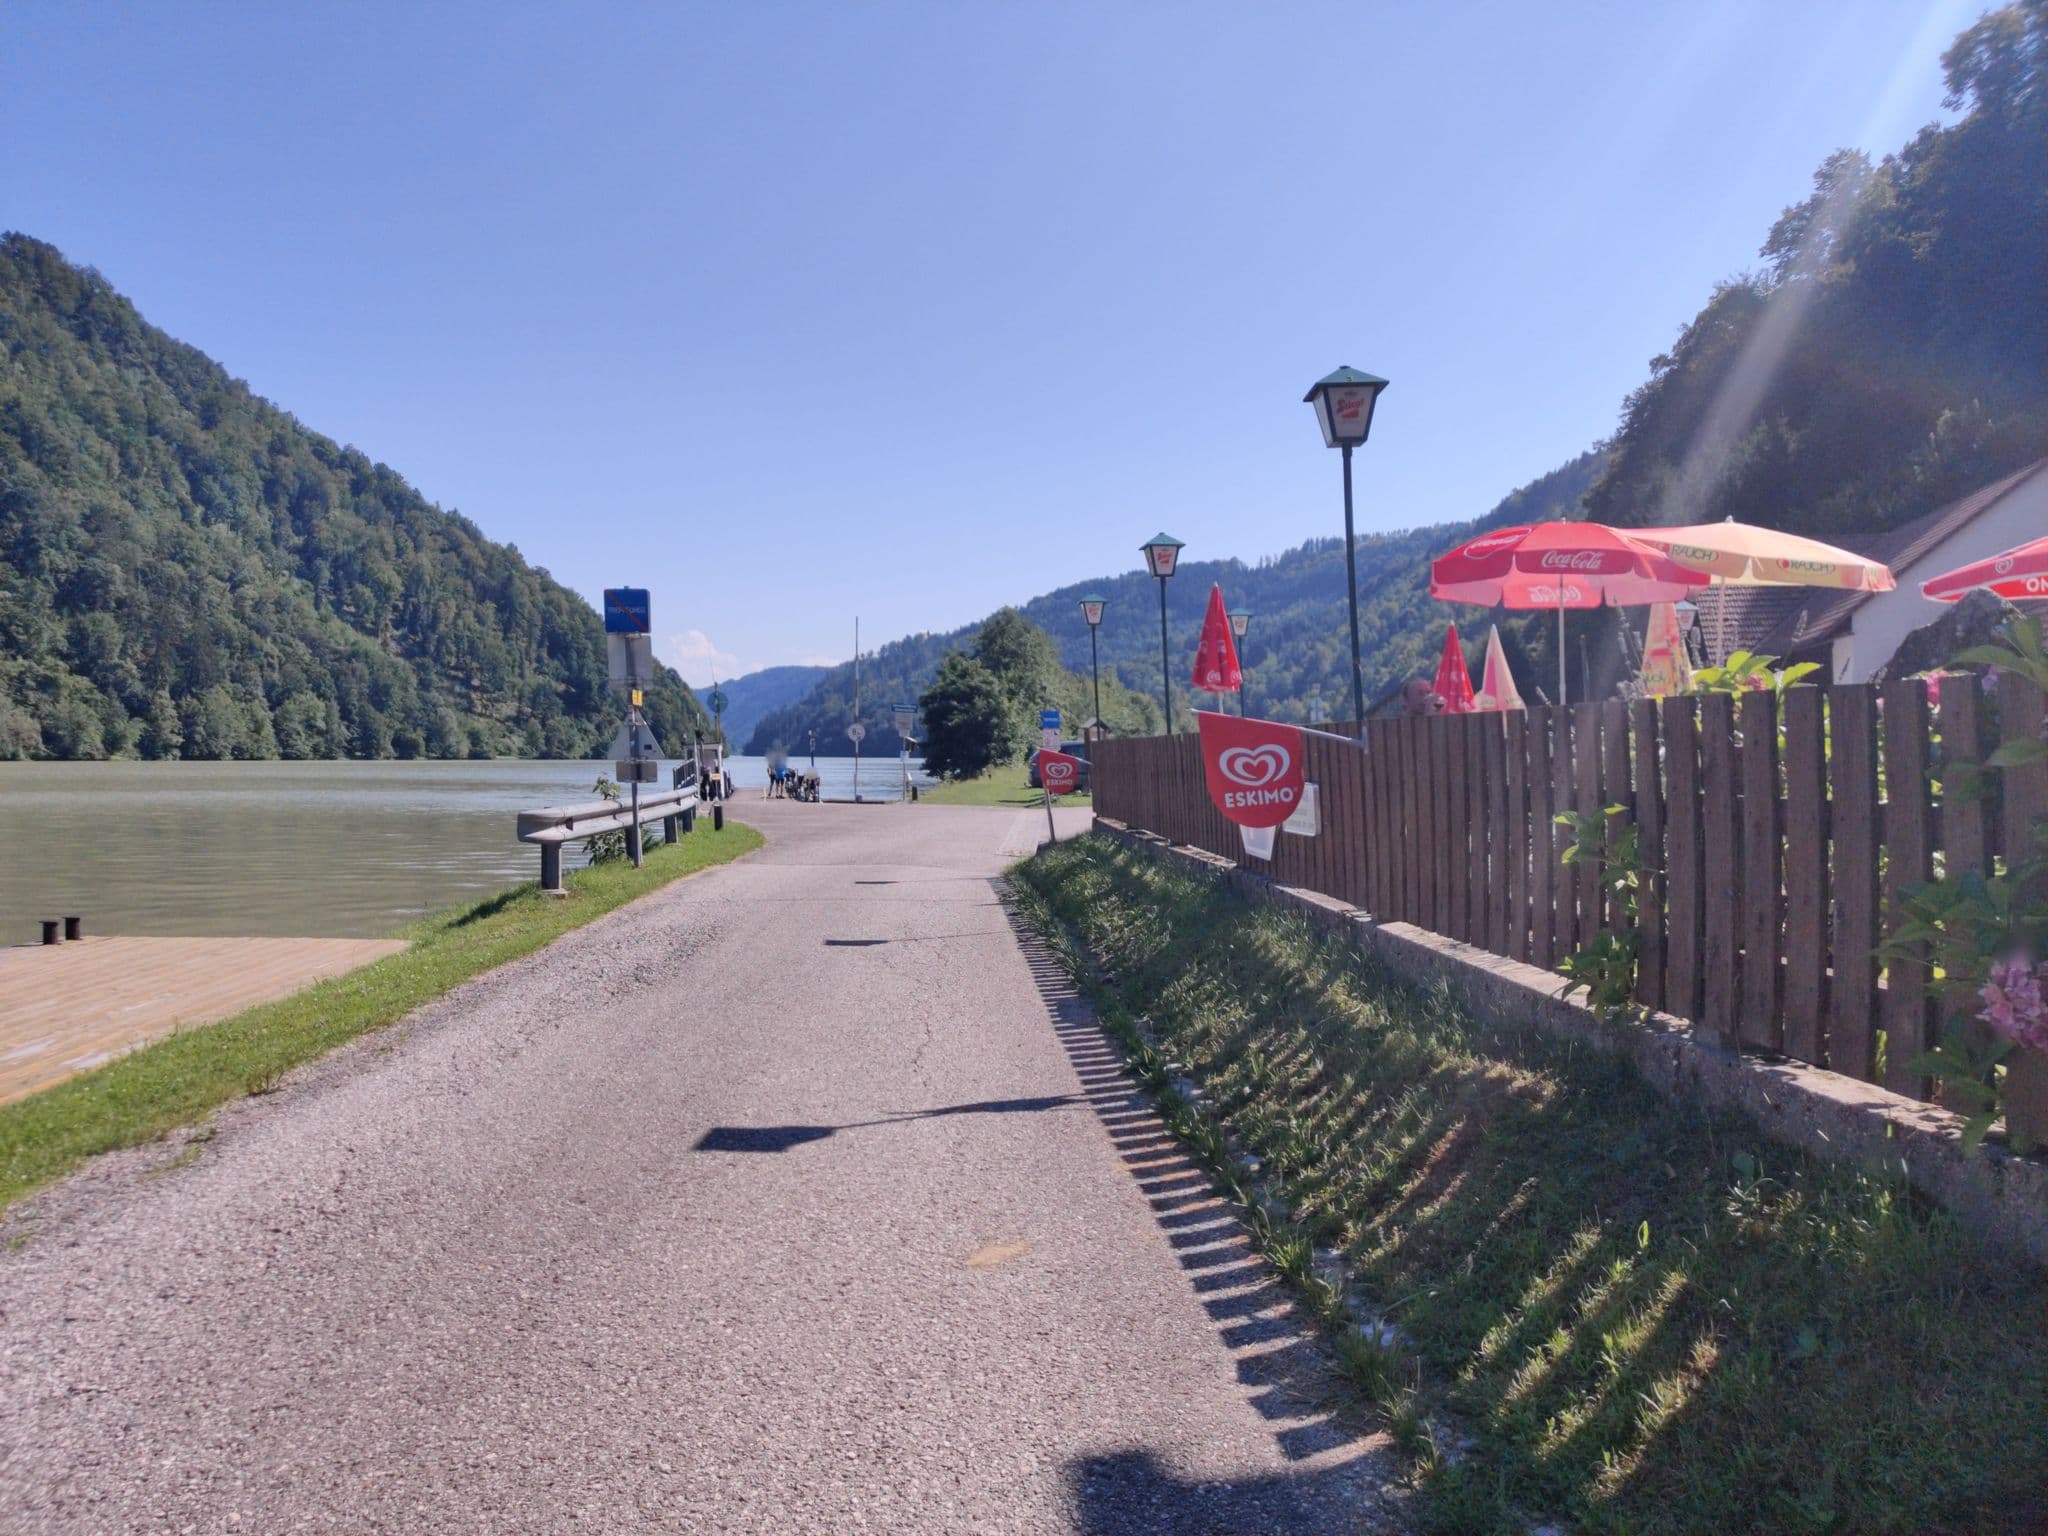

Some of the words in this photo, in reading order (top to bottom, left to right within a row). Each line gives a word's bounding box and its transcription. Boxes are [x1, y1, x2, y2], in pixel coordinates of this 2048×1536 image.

[1672, 543, 1712, 561] RAUCH
[1790, 559, 1830, 573] RAUCH
[1224, 787, 1294, 808] ESKIMO
